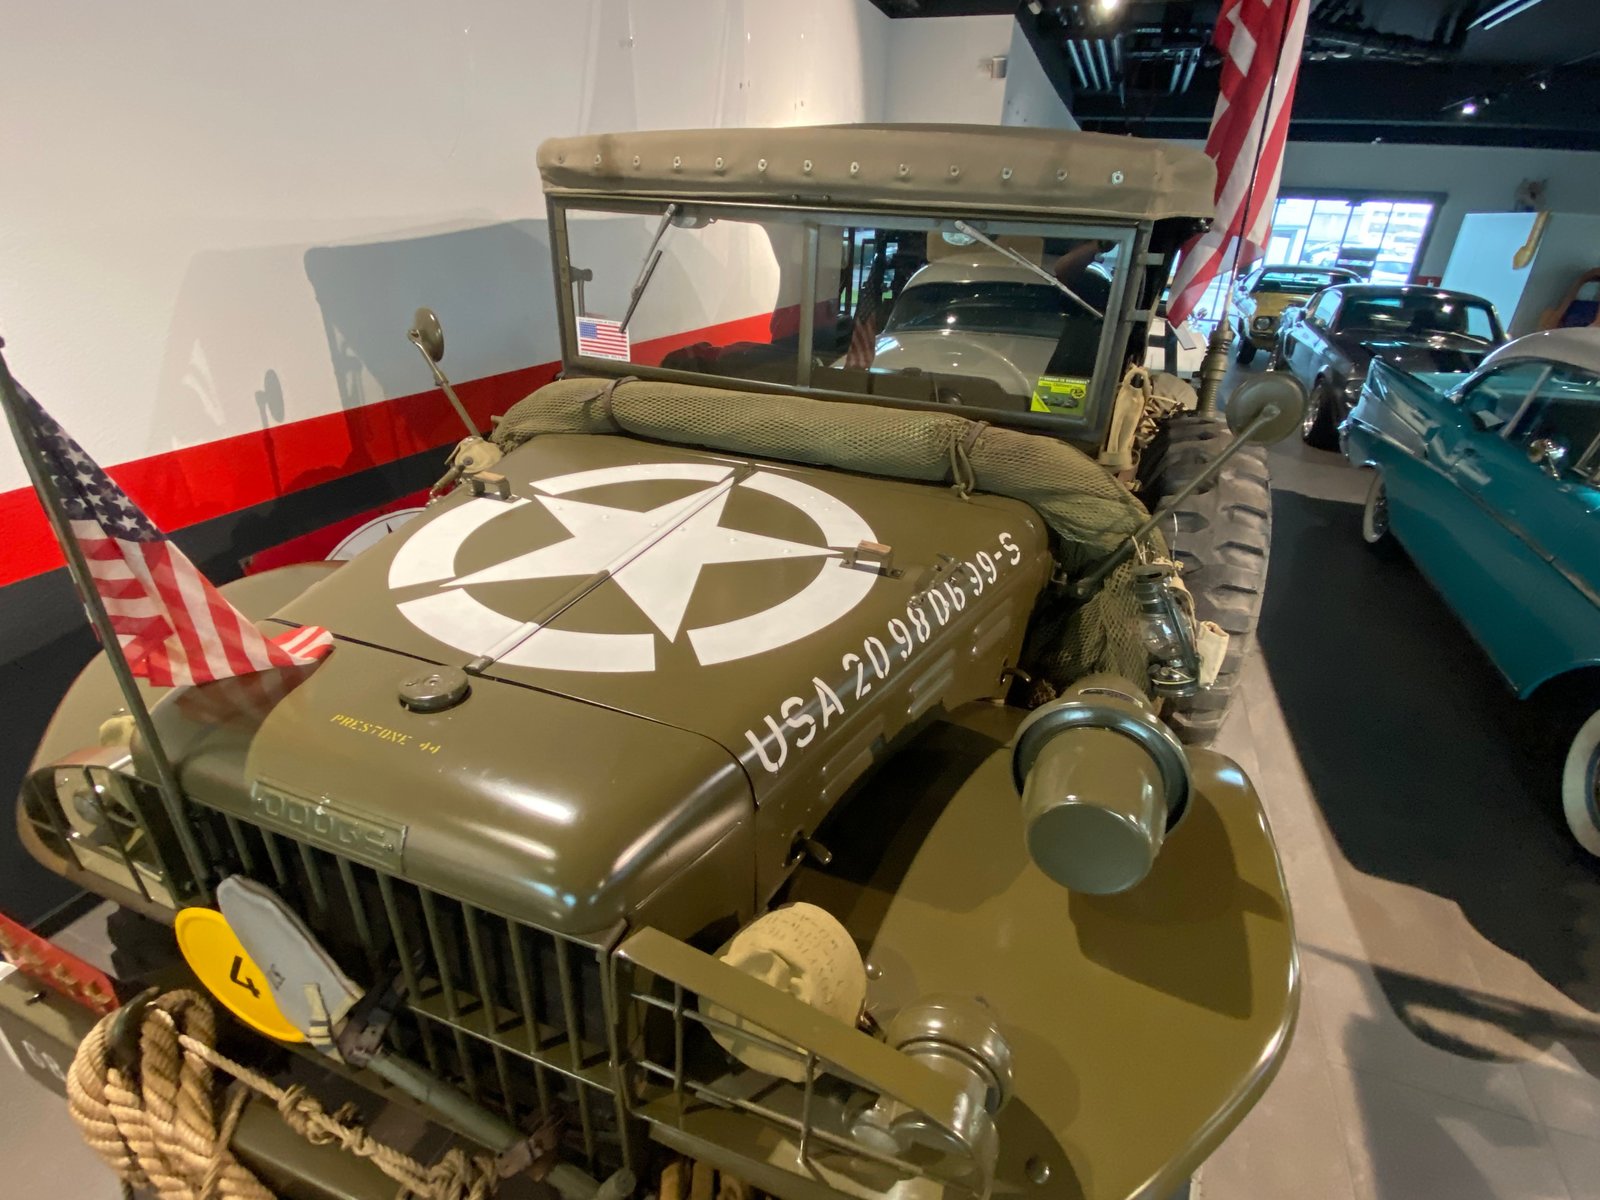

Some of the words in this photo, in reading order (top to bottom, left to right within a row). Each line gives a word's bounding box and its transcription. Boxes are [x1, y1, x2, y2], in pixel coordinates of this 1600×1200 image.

[330, 713, 413, 745] PRESTONE
[419, 742, 441, 754] 44
[744, 677, 845, 773] USA
[229, 955, 261, 999] 4
